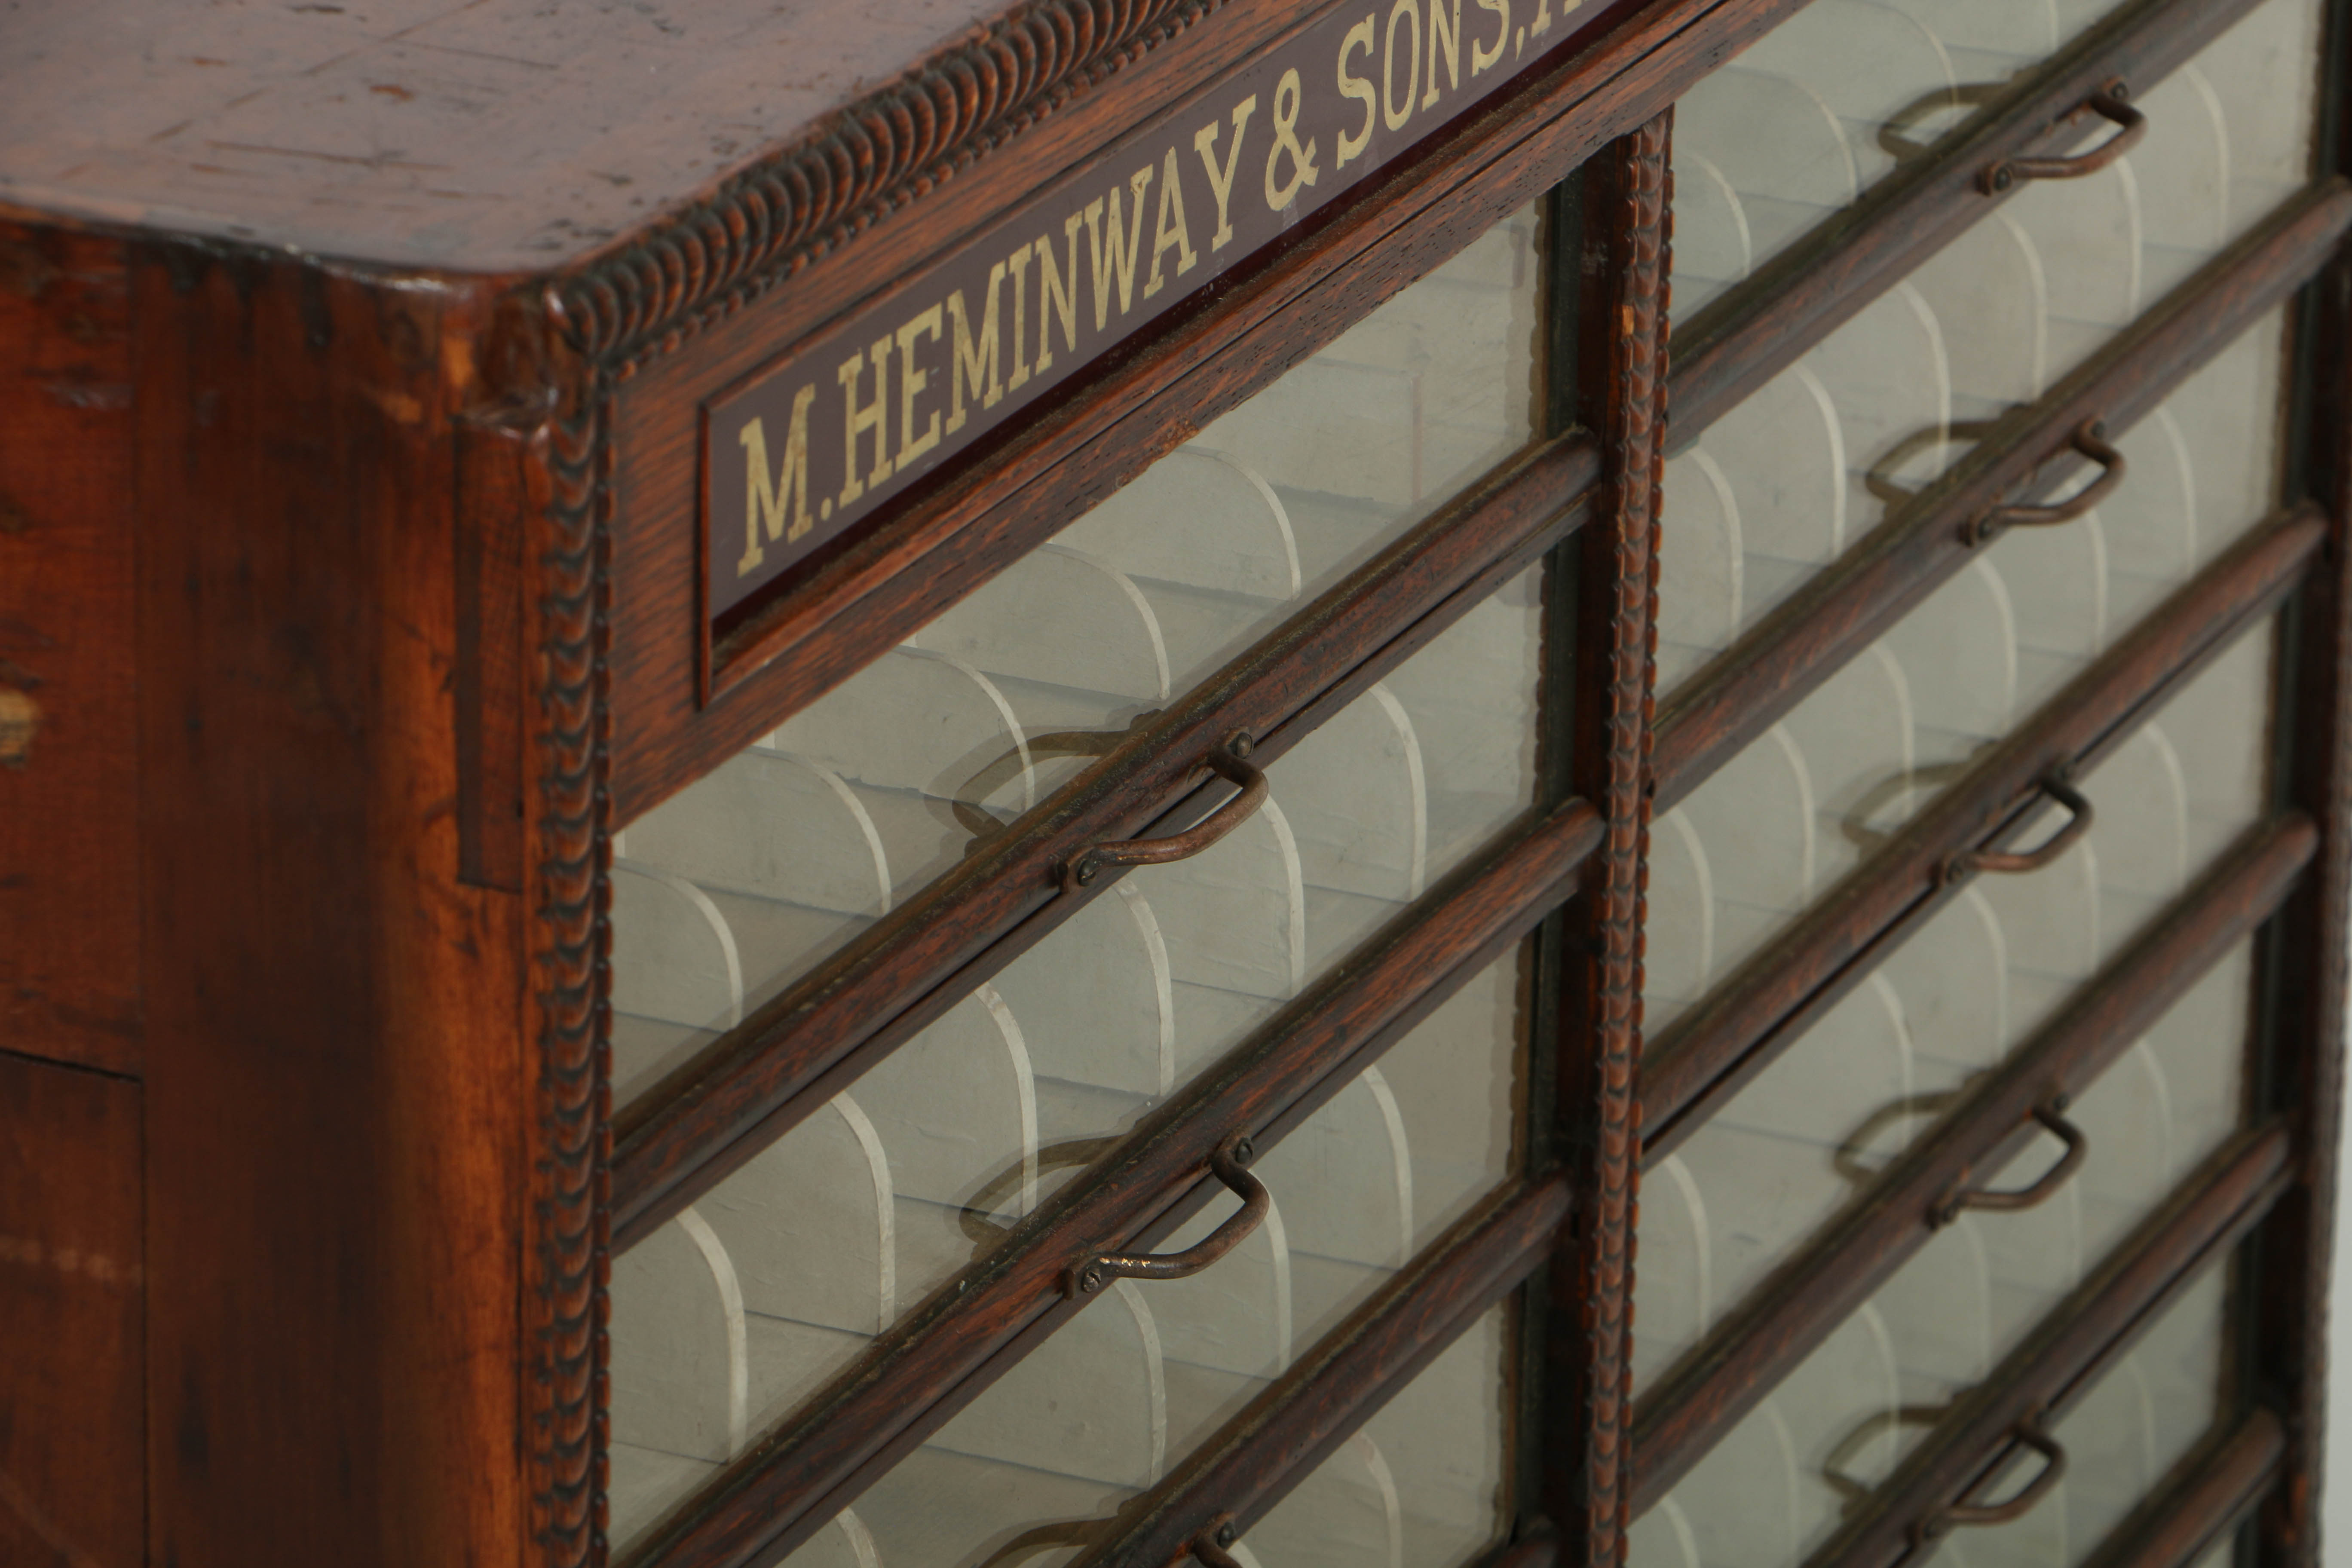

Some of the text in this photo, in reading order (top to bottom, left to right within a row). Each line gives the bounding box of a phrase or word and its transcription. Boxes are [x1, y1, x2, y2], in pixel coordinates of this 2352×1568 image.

[737, 383, 833, 577] M.
[837, 92, 1257, 509] HEMINWAY
[1265, 67, 1320, 212] &
